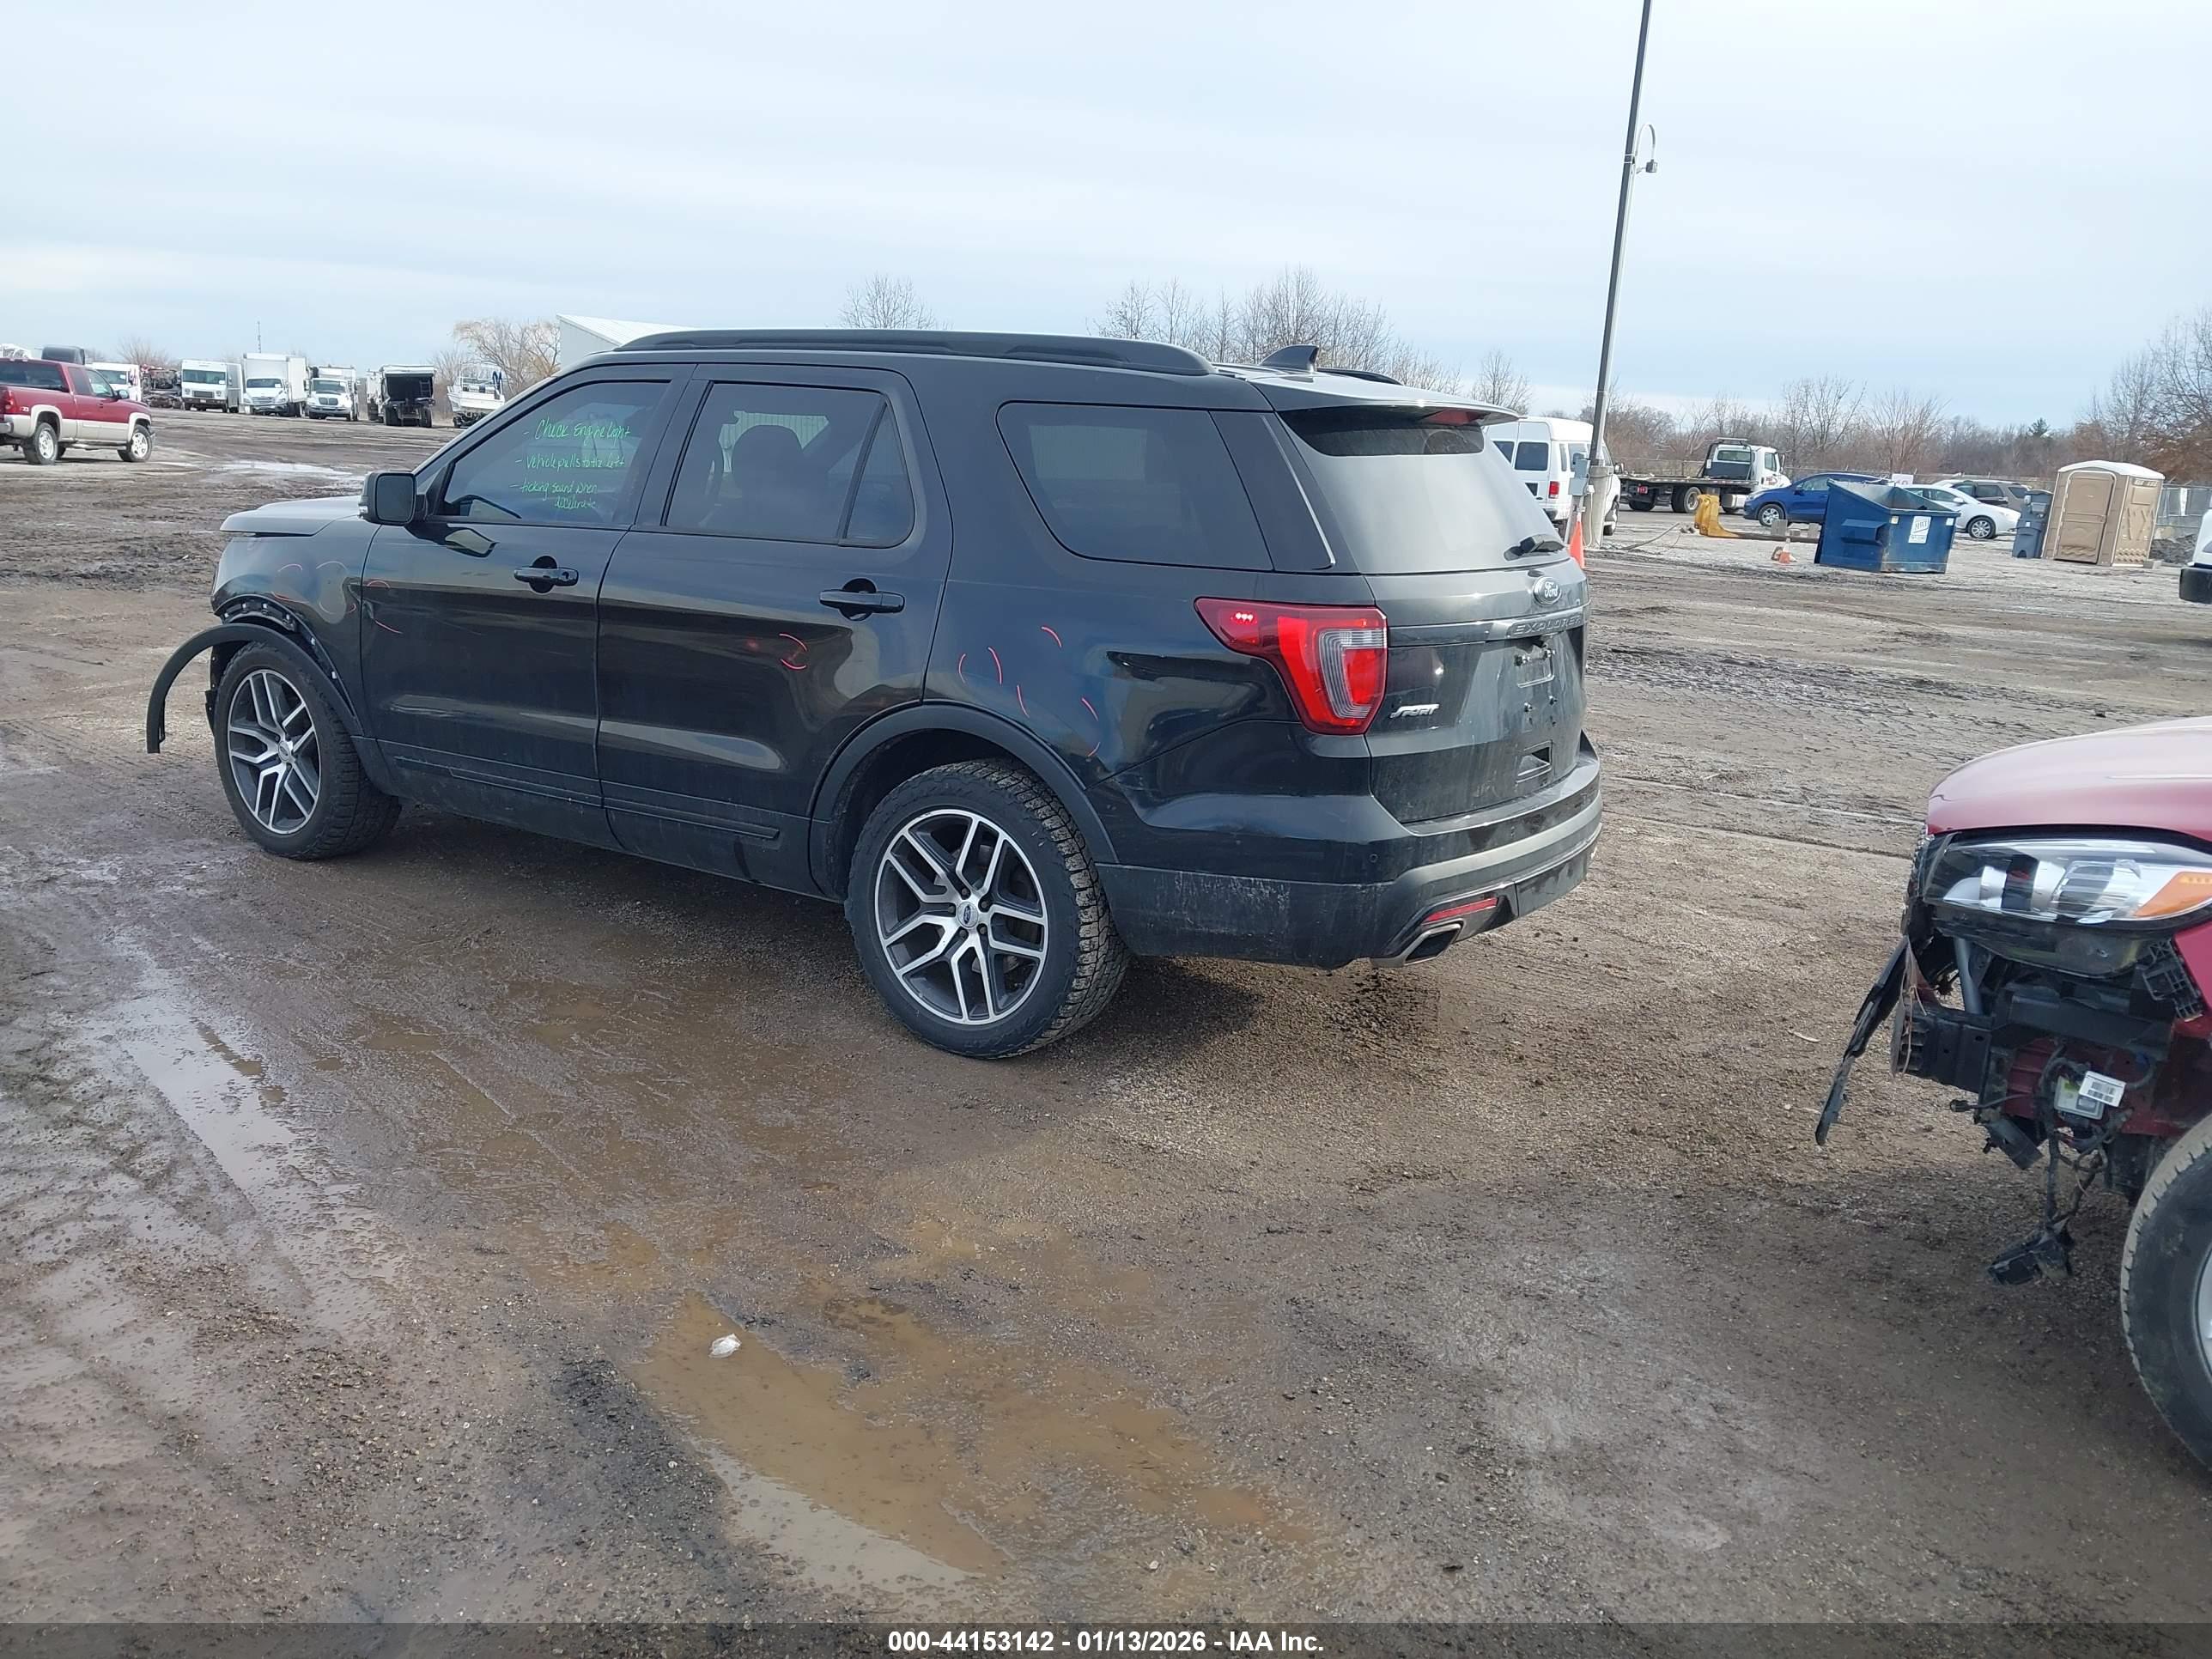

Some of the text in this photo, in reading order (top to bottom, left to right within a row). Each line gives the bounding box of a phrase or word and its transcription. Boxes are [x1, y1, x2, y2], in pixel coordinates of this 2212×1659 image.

[556, 453, 581, 472] pulls
[1513, 615, 1581, 635] EXPLORER
[1389, 703, 1440, 719] SPORT
